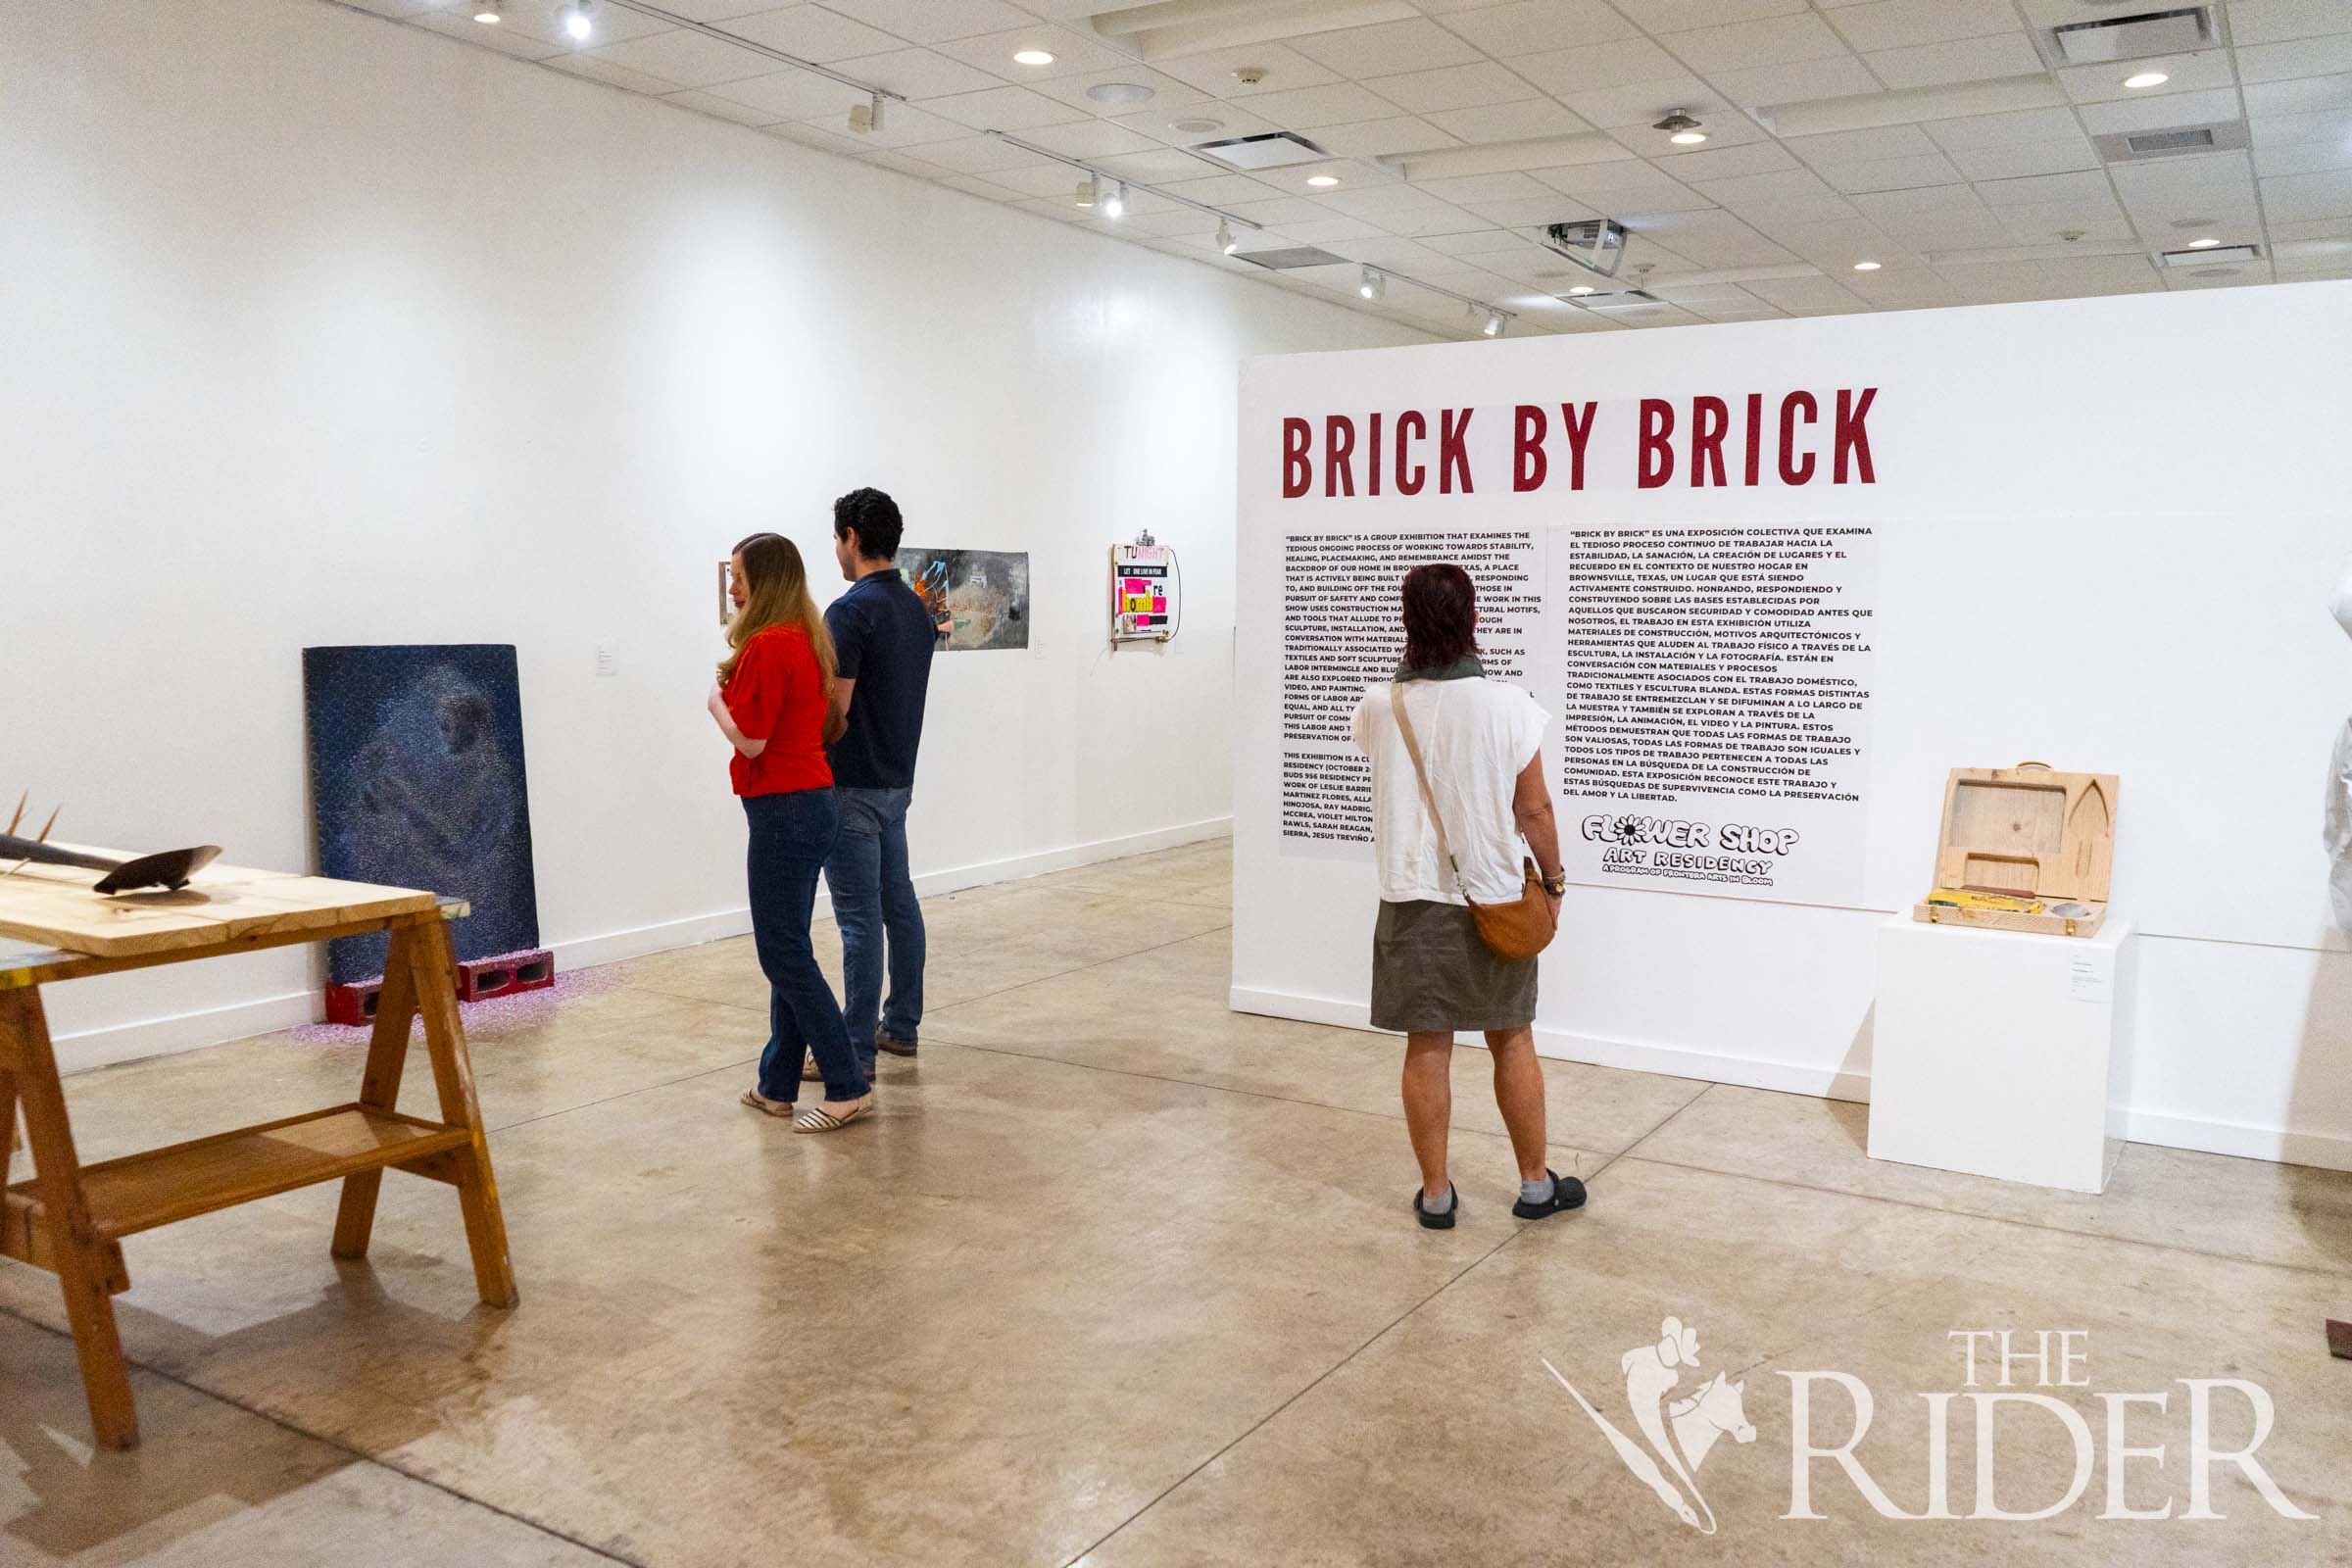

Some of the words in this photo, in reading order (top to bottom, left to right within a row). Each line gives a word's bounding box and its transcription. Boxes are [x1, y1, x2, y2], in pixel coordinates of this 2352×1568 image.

[1283, 408, 1474, 499] BRICK
[1513, 402, 1598, 492] BY
[1638, 388, 1879, 489] BRICK
[1688, 527, 1744, 537] EXPOSICIÓN
[1803, 527, 1823, 536] QUE
[1646, 550, 1696, 560] SANACIÓN,
[1713, 550, 1761, 559] CREACIÓN
[1741, 572, 1766, 582] ESTÁ
[1567, 661, 1636, 669] CONVERSACIÓN
[1659, 662, 1717, 671] MATERIALES
[1594, 682, 1635, 691] TEXTILES
[1644, 684, 1697, 693] ESCULTURA
[1743, 687, 1773, 696] ESTAS
[1775, 688, 1816, 697] FORMAS
[1818, 690, 1870, 699] DISTINTAS
[1566, 723, 1607, 733] MÉTODOS
[1609, 726, 1670, 736] DEMUESTRAN
[1693, 730, 1725, 739] TODAS
[1747, 732, 1788, 741] FORMAS
[1805, 735, 1852, 744] TRABAJO
[1301, 753, 1344, 761] EXHIBITION
[1320, 773, 1361, 782] RESIDENCY
[1564, 767, 1620, 777] COMUNIDAD.
[1646, 771, 1701, 782] EXPOSICIÓN
[1704, 774, 1755, 784] RECONOCE
[1783, 779, 1829, 788] TRABAJO
[1284, 791, 1321, 800] MARTINEZ
[1322, 793, 1352, 803] FLORES,
[1632, 793, 1678, 802] LIBERTAD.
[1283, 829, 1311, 839] SIERRA,
[1312, 831, 1335, 840] JESUS
[1337, 833, 1369, 843] TREVIÑO
[1582, 814, 1710, 848] FLOWER
[1720, 823, 1799, 856] SHOP
[1603, 847, 1646, 863] ART
[1654, 852, 1773, 875] RESIDENCY
[1602, 863, 1608, 872] A
[1609, 864, 1648, 875] PROGRAM
[1649, 867, 1662, 876] OF
[1663, 868, 1705, 880] FRONTERA
[1707, 873, 1728, 882] ARTS
[1729, 874, 1740, 883] IN
